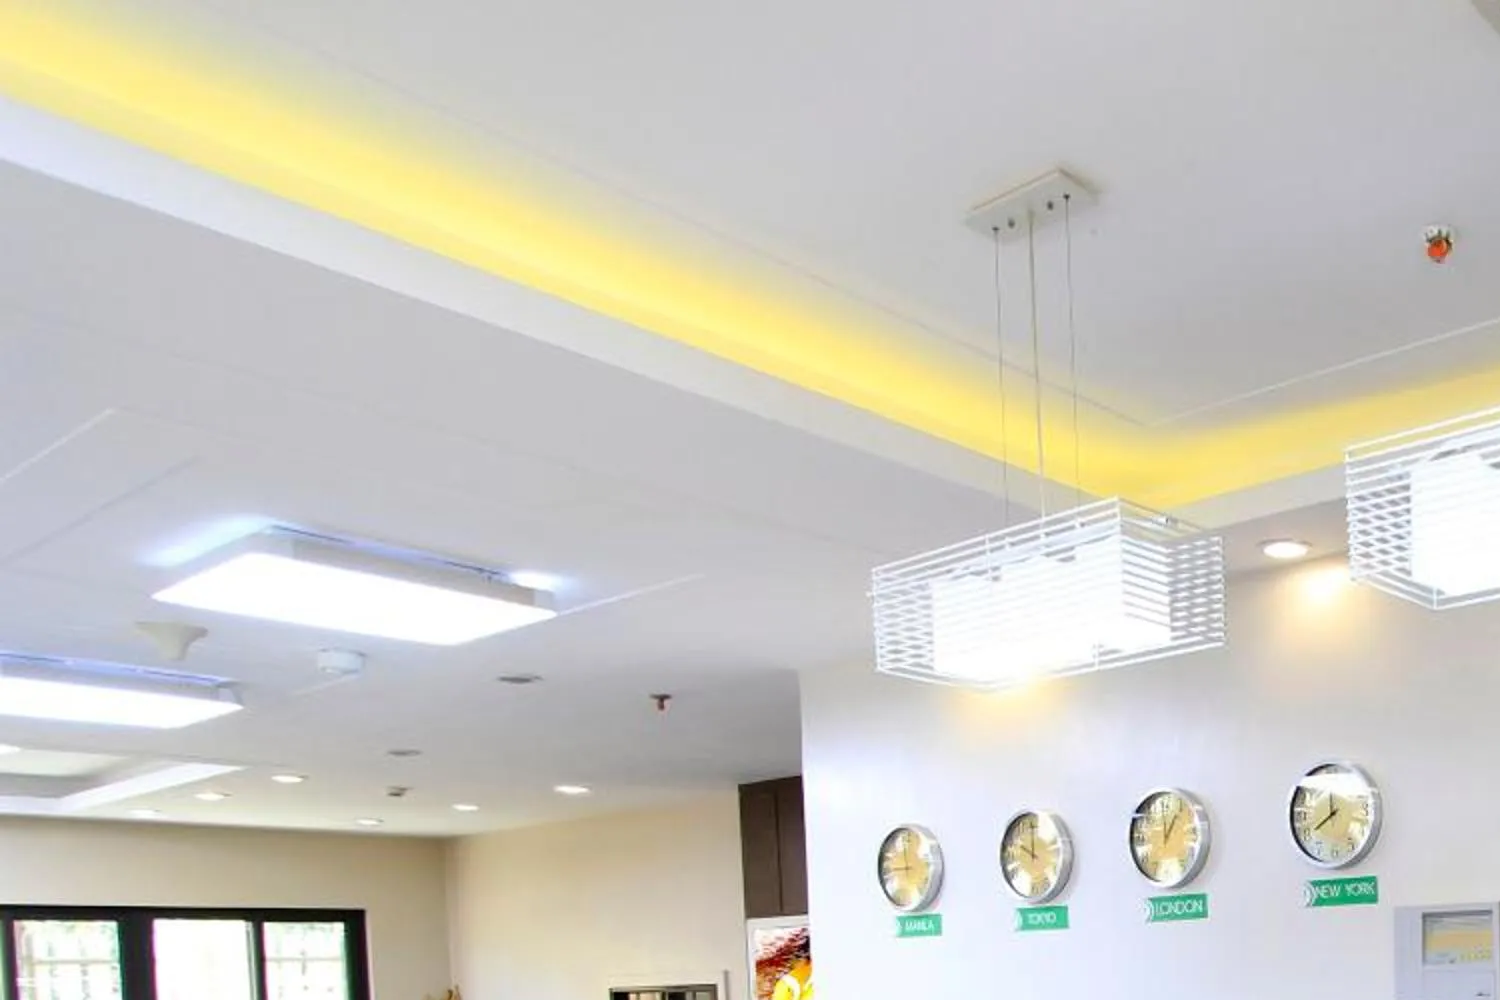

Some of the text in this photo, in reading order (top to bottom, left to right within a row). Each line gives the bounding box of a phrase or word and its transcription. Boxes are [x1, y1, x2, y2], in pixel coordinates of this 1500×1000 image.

[1312, 881, 1375, 898] NEW YORK
[1156, 899, 1203, 915] LONDON
